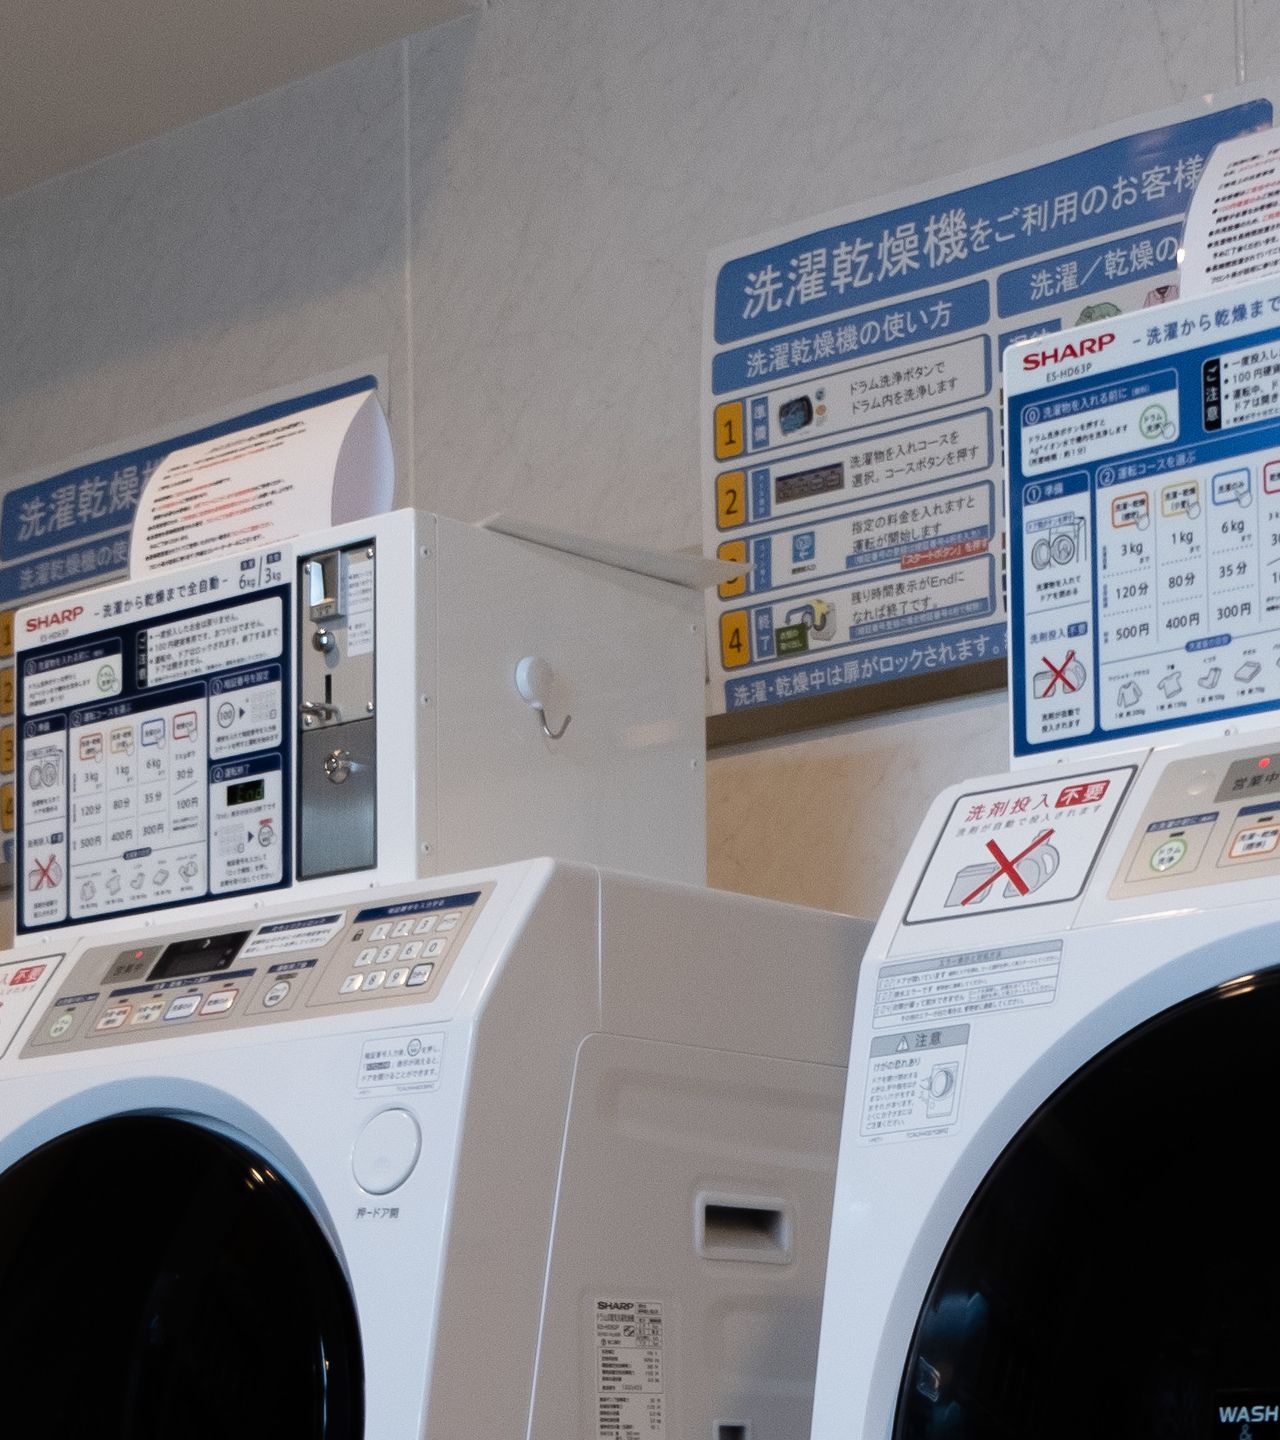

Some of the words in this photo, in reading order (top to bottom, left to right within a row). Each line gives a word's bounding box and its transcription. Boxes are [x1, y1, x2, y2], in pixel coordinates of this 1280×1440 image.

[745, 299, 953, 379] 洗濯乾燥機の使い方
[1022, 333, 1116, 371] SHARP
[849, 360, 946, 395] ドラム洗浄ボタンで
[1046, 362, 1093, 383] ES-HD63P
[851, 376, 958, 415] ドラム内を洗浄します
[723, 419, 736, 446] 1
[849, 430, 960, 469] 洗濯物を入れコースを
[725, 489, 738, 516] 2
[851, 496, 976, 533] 指定の料金を入れますと
[1221, 520, 1245, 534] 6kg
[1172, 531, 1193, 545] 1kg
[1122, 542, 1143, 556] 3kg
[1220, 561, 1247, 579] 35分
[1169, 572, 1196, 589] 80分
[1116, 582, 1149, 600] 120分
[25, 605, 84, 633] SHARP
[1166, 613, 1200, 630] 400円
[1217, 602, 1251, 621] 300円
[1115, 623, 1150, 641] 500円
[729, 629, 742, 656] 4
[1232, 772, 1280, 791] 営業中
[966, 794, 1051, 823] 洗剤投入
[1063, 782, 1108, 807] 不要
[915, 1031, 942, 1047] 注意
[597, 1300, 634, 1311] SHARP
[1218, 1404, 1279, 1424] WASH
